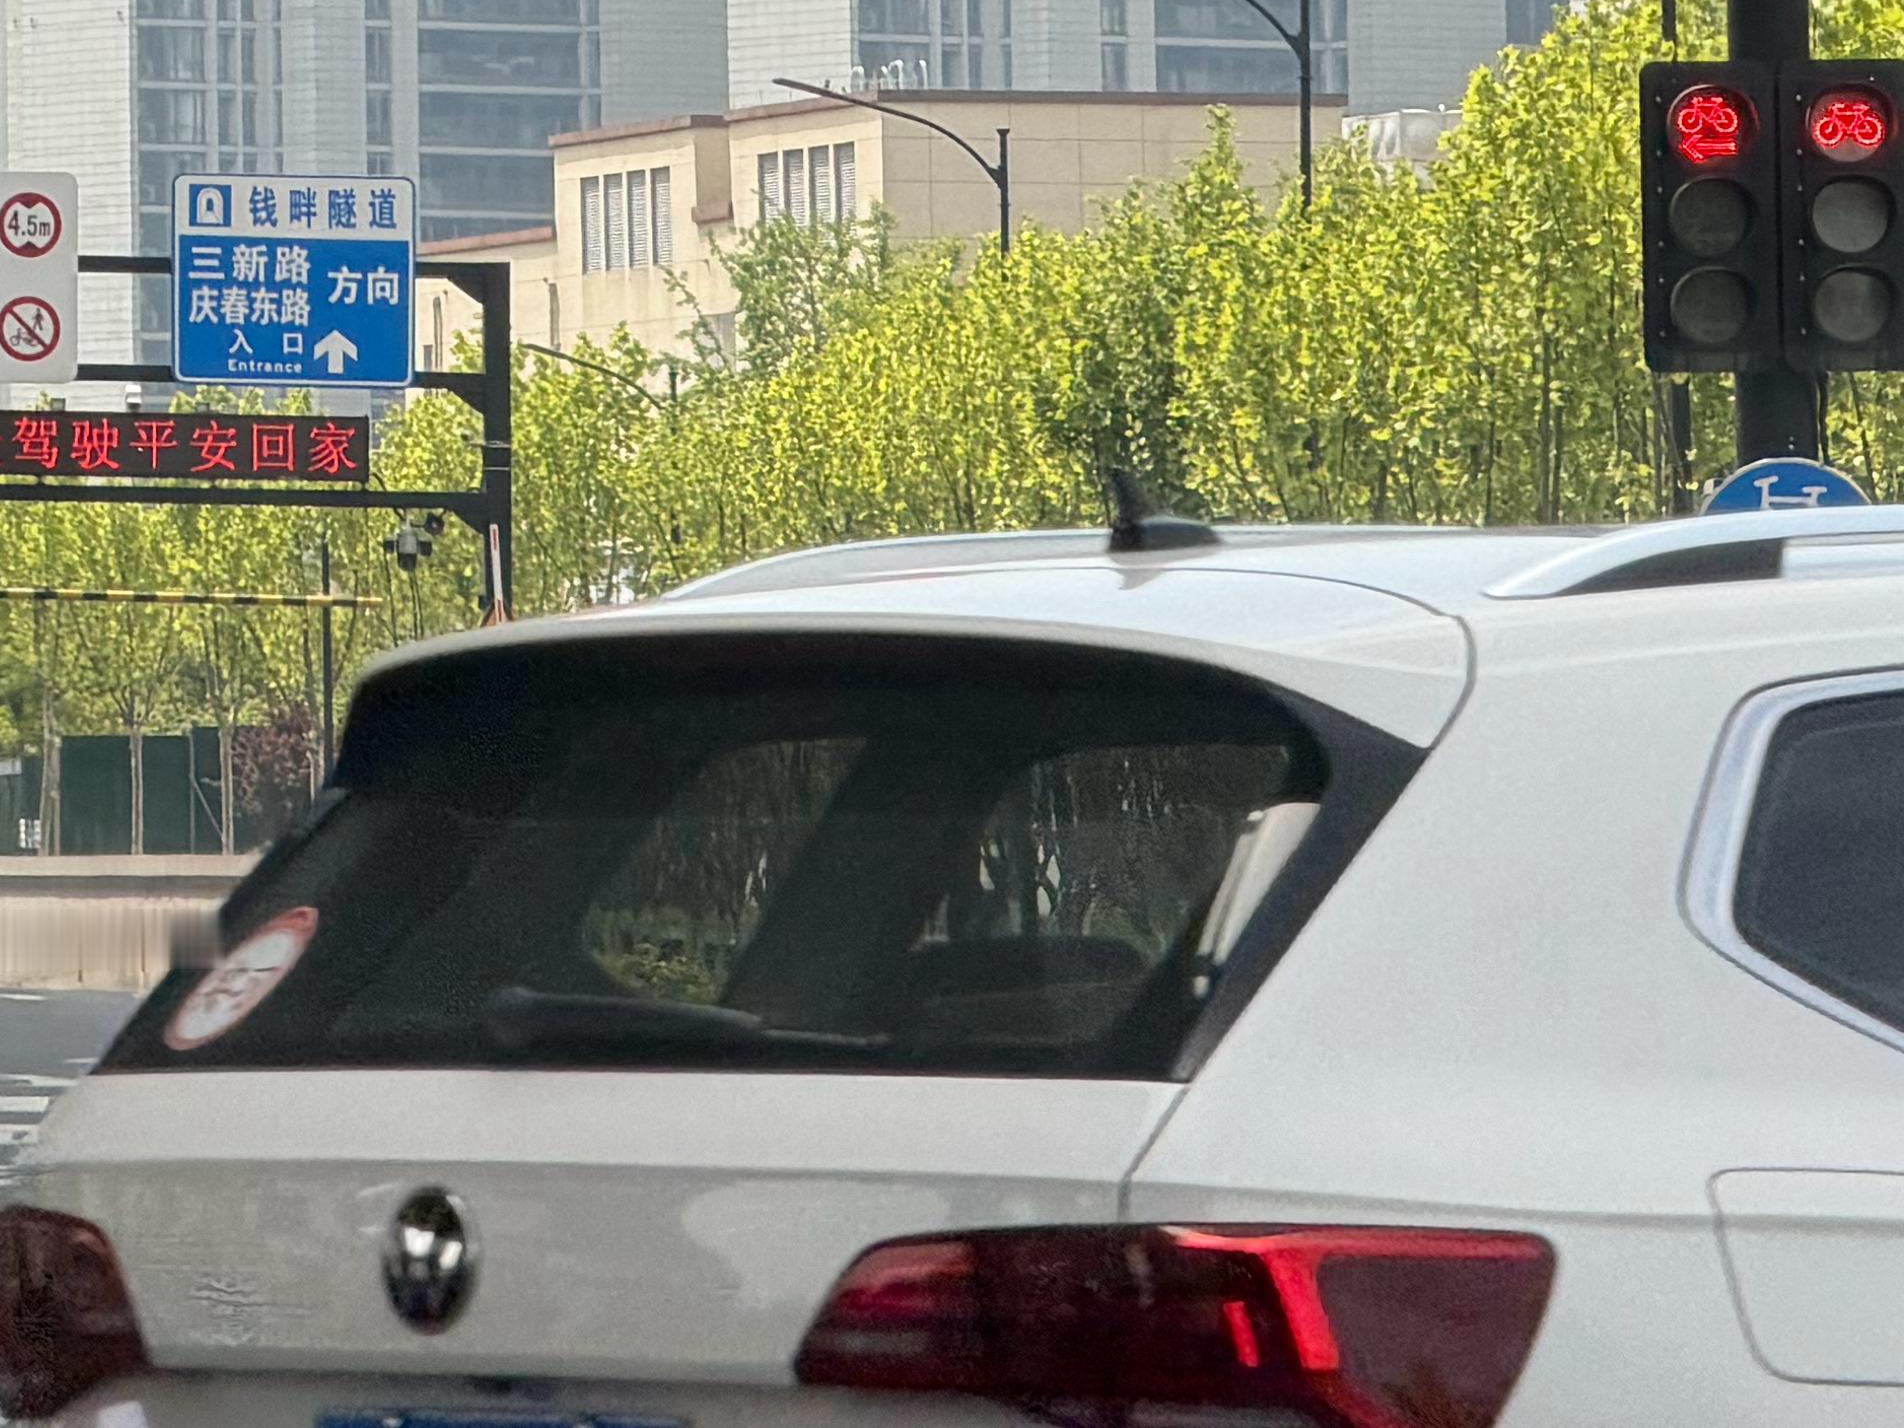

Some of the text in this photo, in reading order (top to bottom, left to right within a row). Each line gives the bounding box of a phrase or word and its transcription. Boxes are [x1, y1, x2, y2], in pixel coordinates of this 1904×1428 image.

[7, 210, 51, 237] 4.5m
[249, 185, 397, 230] 钱畔隧道
[188, 243, 311, 286] 三新路
[327, 264, 399, 305] 方向
[189, 286, 311, 327] 庆春东路
[228, 329, 303, 355] 入口
[228, 358, 303, 374] Entrance
